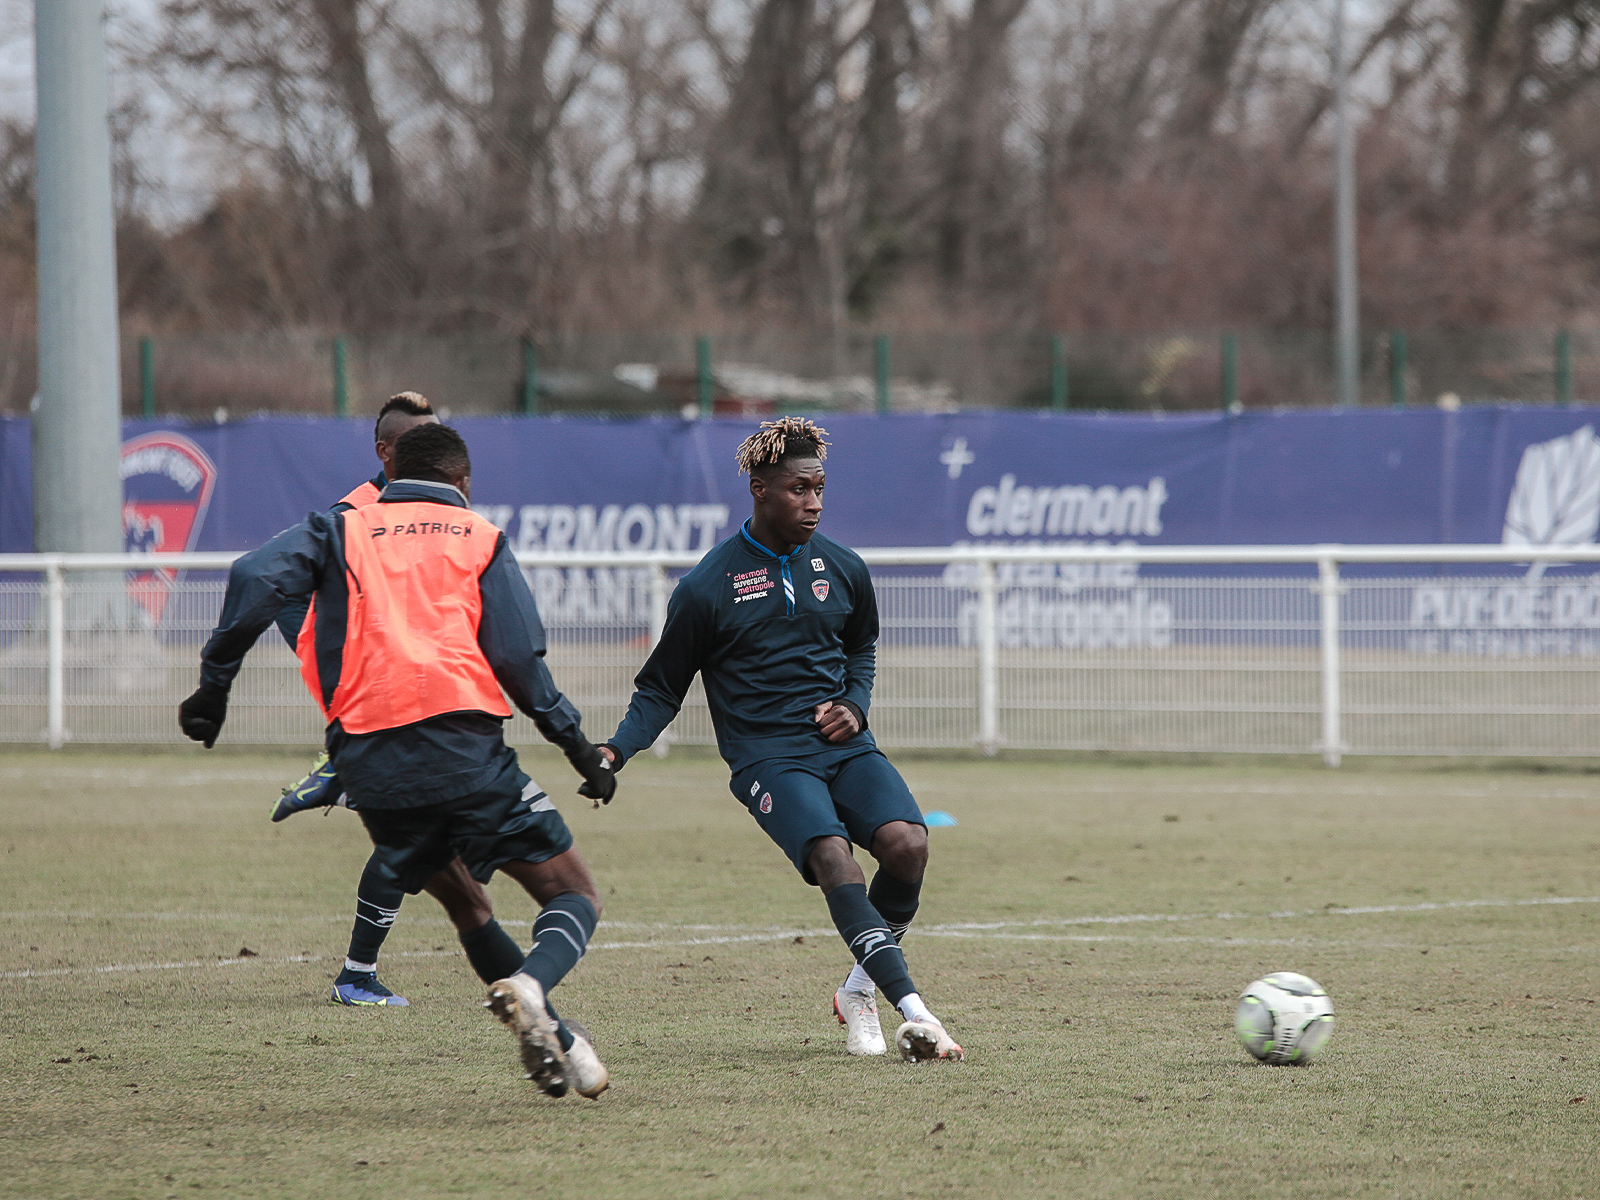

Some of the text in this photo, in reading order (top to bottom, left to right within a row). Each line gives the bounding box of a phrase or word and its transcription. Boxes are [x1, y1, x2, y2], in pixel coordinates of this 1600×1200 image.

[966, 473, 1169, 537] clermont
[393, 522, 473, 538] PATRICK
[733, 567, 768, 581] clermont
[733, 575, 767, 589] auvergne
[742, 591, 768, 601] PATRICK
